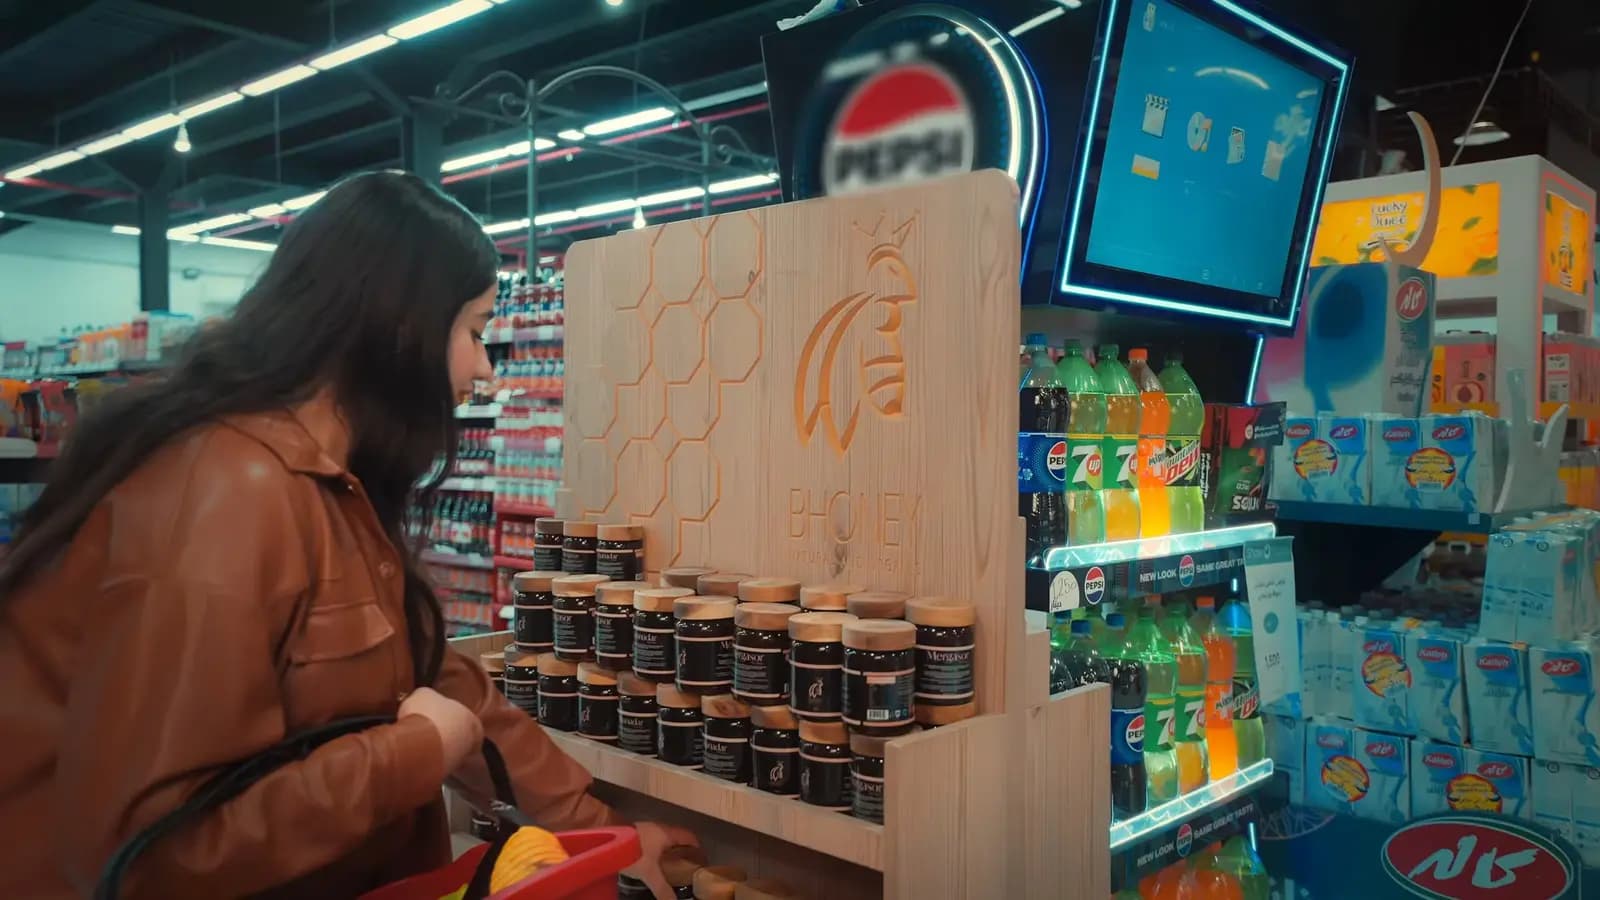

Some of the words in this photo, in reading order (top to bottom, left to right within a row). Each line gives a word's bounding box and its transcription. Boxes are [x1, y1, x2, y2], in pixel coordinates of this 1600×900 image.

[836, 128, 963, 185] PEPSI
[1139, 571, 1157, 584] NEW
[1158, 568, 1177, 581] LOOK
[1086, 581, 1104, 591] PEPSI
[1155, 842, 1175, 858] LOOK
